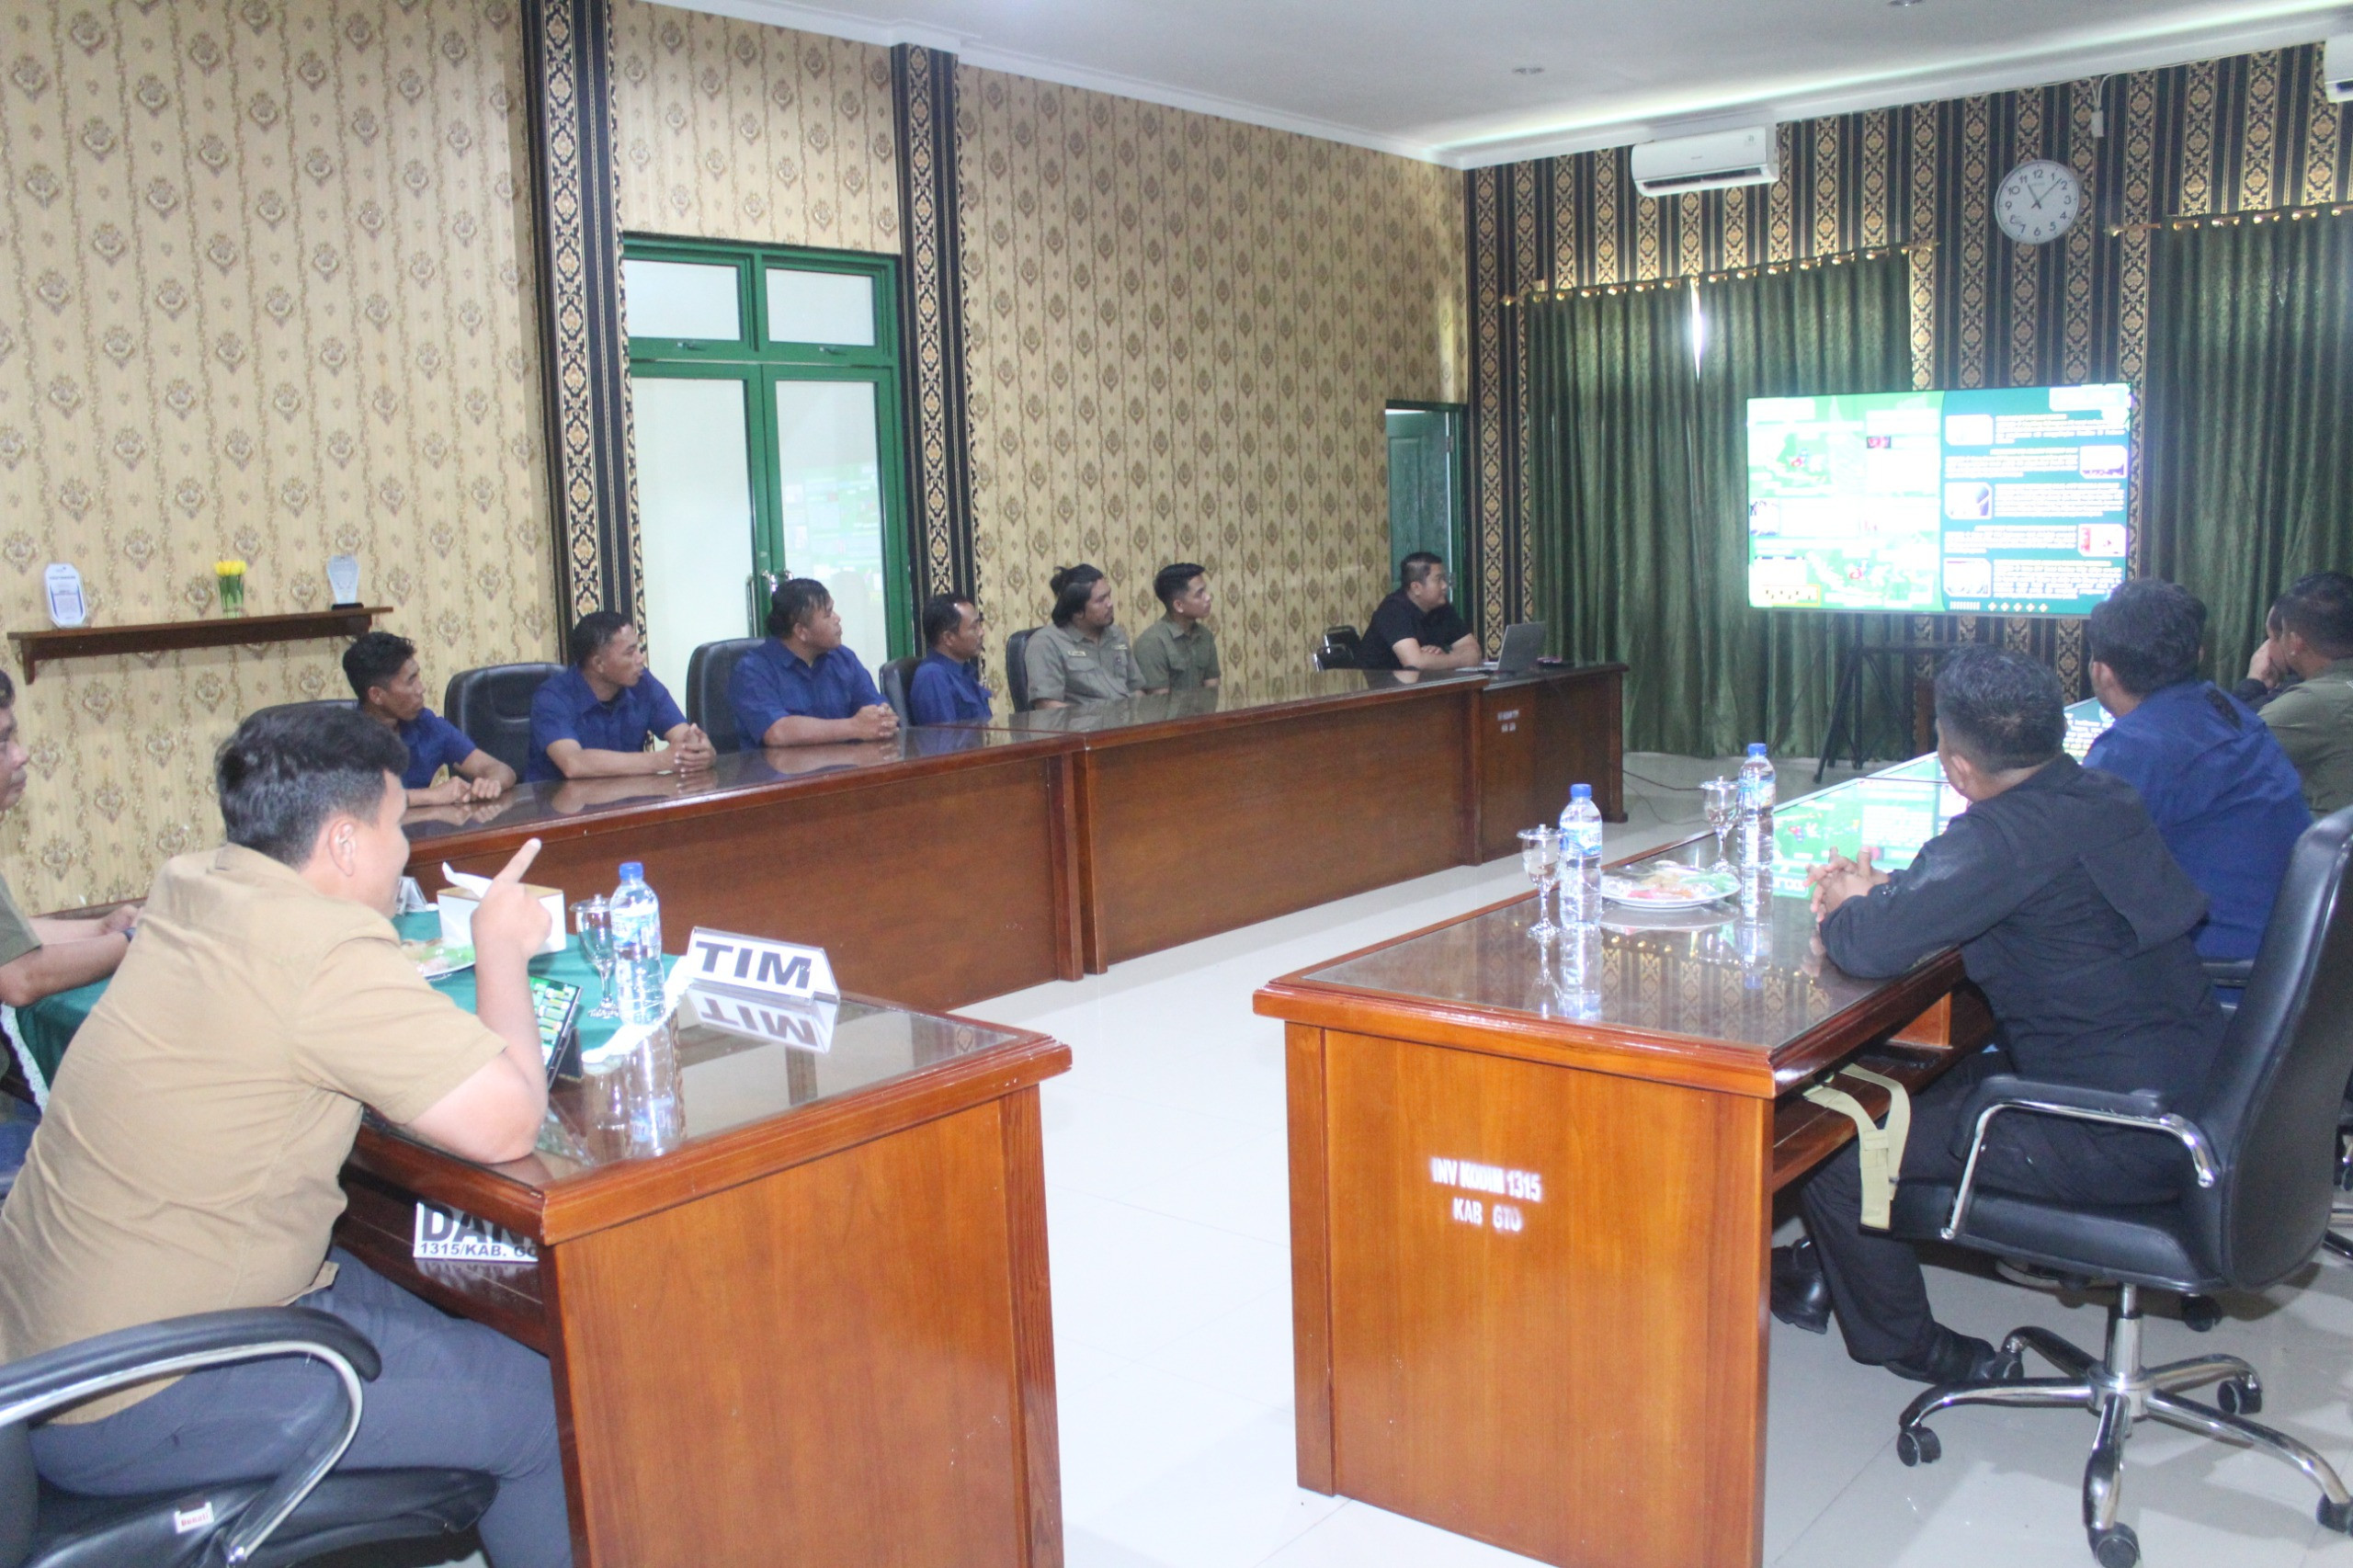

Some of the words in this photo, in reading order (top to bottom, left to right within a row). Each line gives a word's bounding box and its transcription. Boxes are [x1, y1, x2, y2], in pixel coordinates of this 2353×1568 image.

[2032, 169, 2043, 178] 12
[2019, 175, 2028, 183] 11
[2060, 180, 2067, 190] 2
[2008, 186, 2020, 195] 10
[2064, 196, 2072, 204] 3
[2005, 201, 2012, 210] 9
[2059, 211, 2067, 220] 4
[2020, 223, 2026, 233] 7
[2033, 227, 2040, 236] 6
[2049, 222, 2056, 232] 5
[696, 940, 812, 990] TIM
[1506, 1170, 1541, 1202] 1315
[1453, 1198, 1483, 1225] KAB
[422, 1205, 535, 1244] DAN
[421, 1242, 506, 1257] 1315/KAB.
